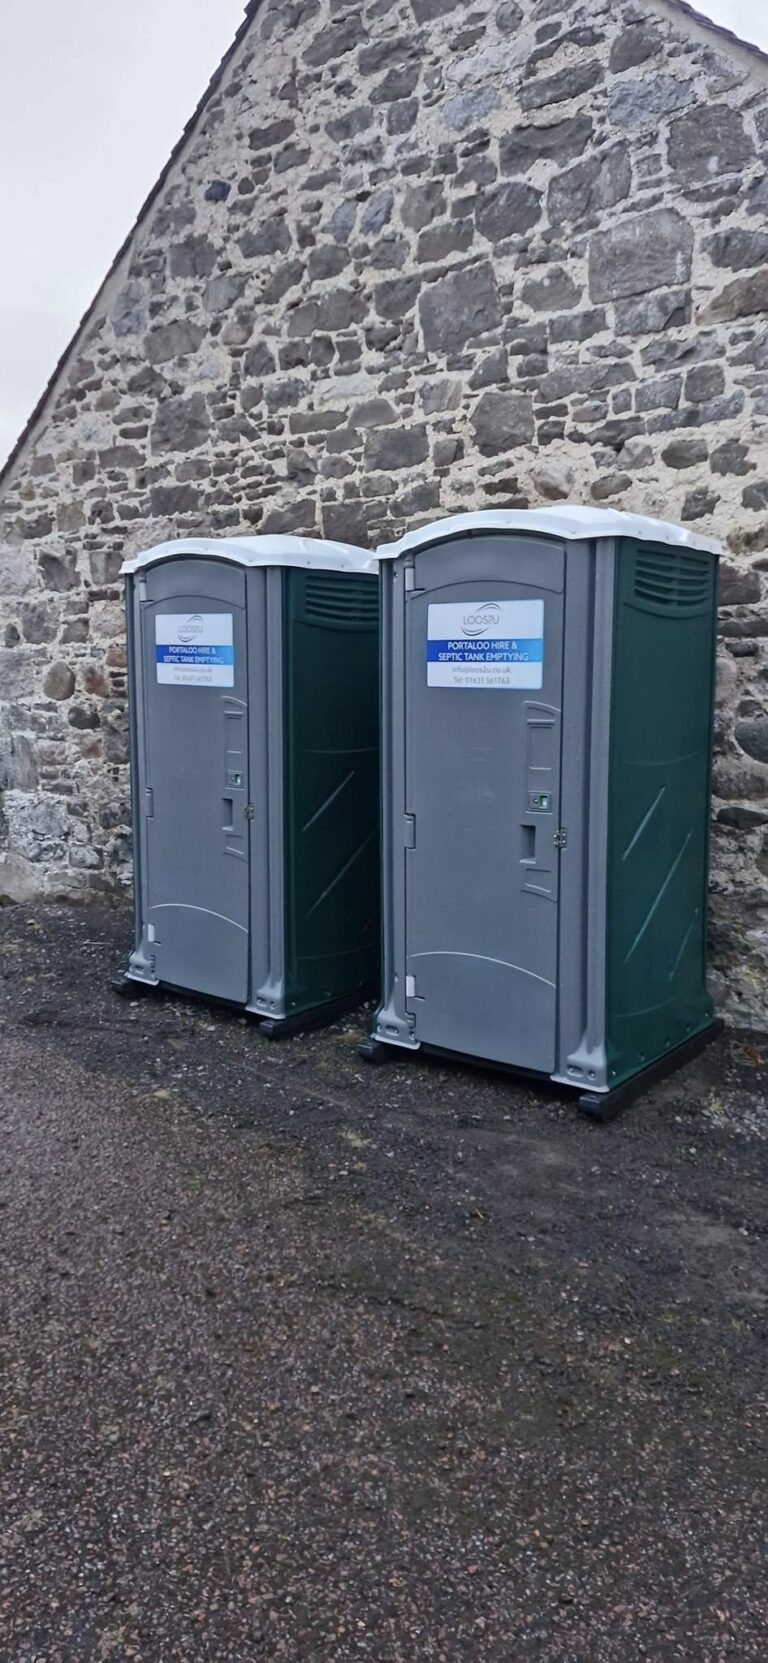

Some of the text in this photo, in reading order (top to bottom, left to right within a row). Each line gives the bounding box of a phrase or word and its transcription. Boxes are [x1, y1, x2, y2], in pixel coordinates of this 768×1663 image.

[447, 641, 518, 650] PORTALOO HIRE &
[168, 646, 198, 654] PORTALOO
[194, 656, 225, 664] EMPTYING
[438, 652, 529, 661] SEPTIC TANK EMPTYING
